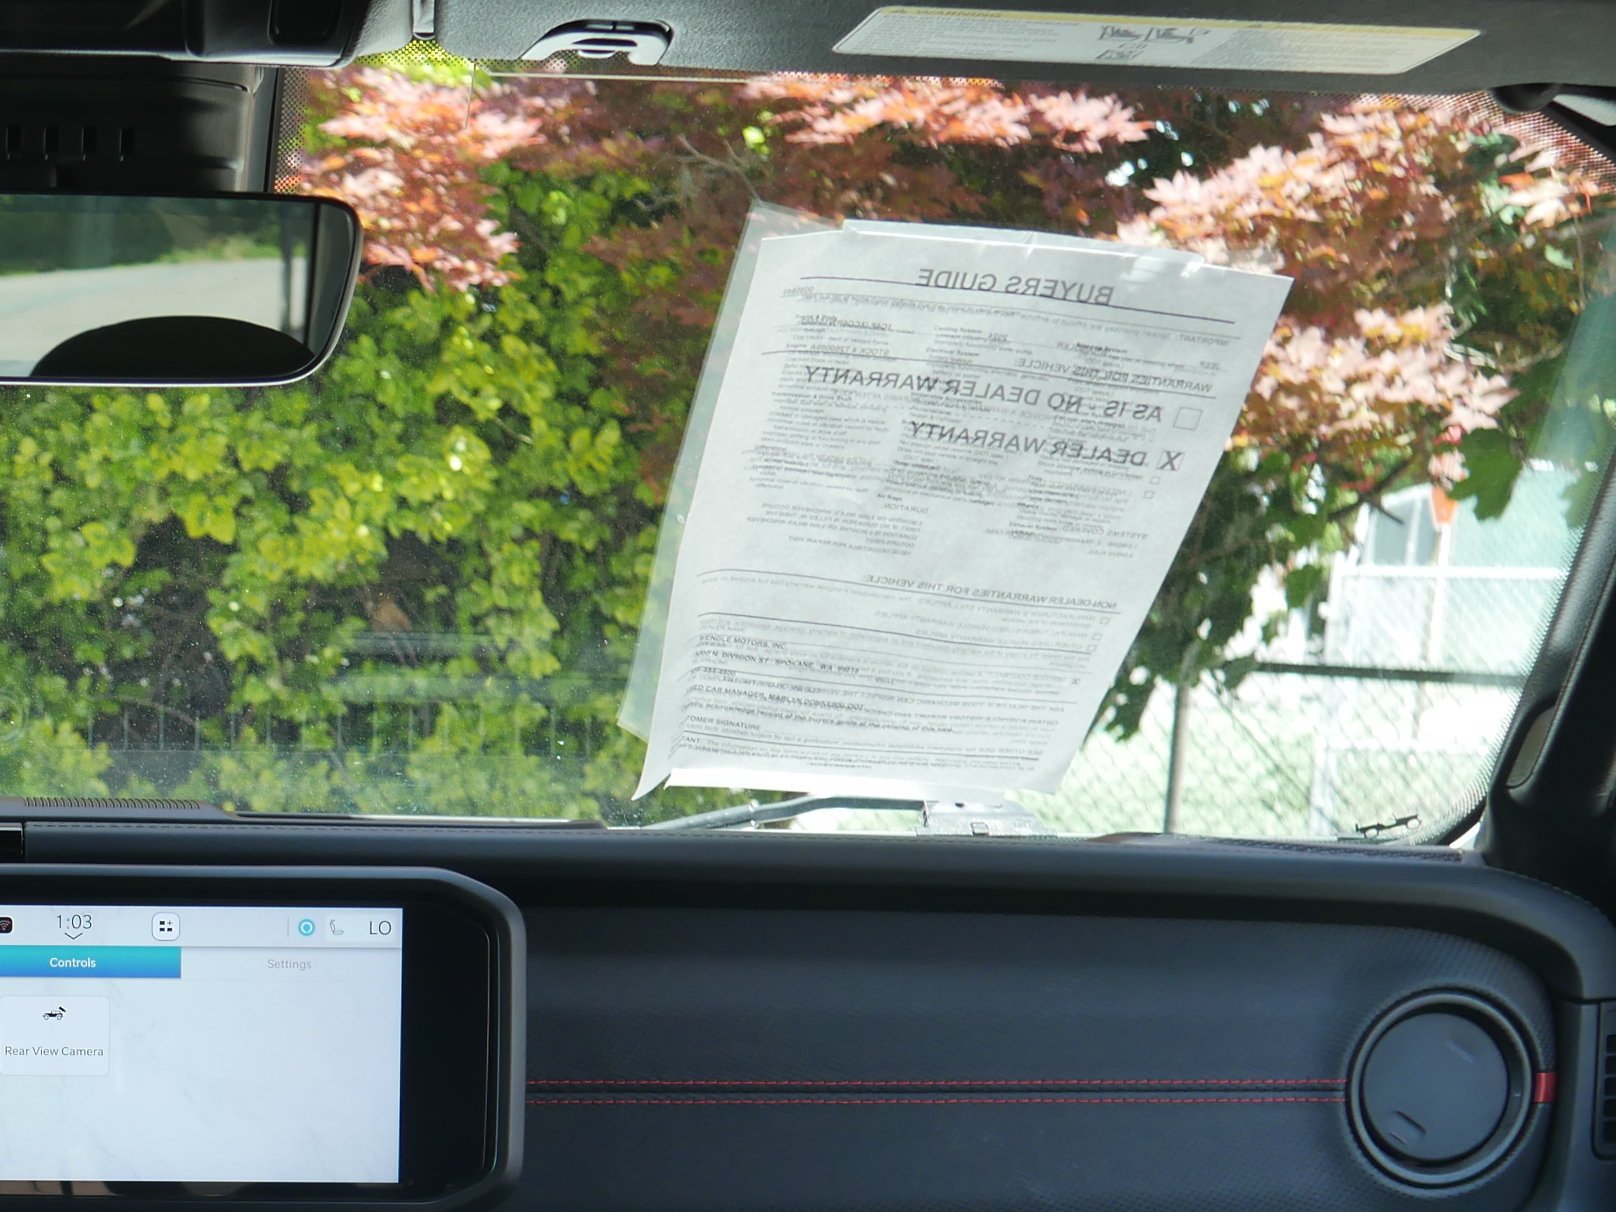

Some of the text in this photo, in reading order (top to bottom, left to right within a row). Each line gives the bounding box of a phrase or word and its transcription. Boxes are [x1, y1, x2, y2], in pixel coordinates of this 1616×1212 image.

[56, 914, 92, 930] 1:03
[369, 920, 392, 936] LO
[49, 957, 96, 969] Controls
[267, 958, 312, 971] Settings
[4, 1046, 104, 1057] Rear View Camera
